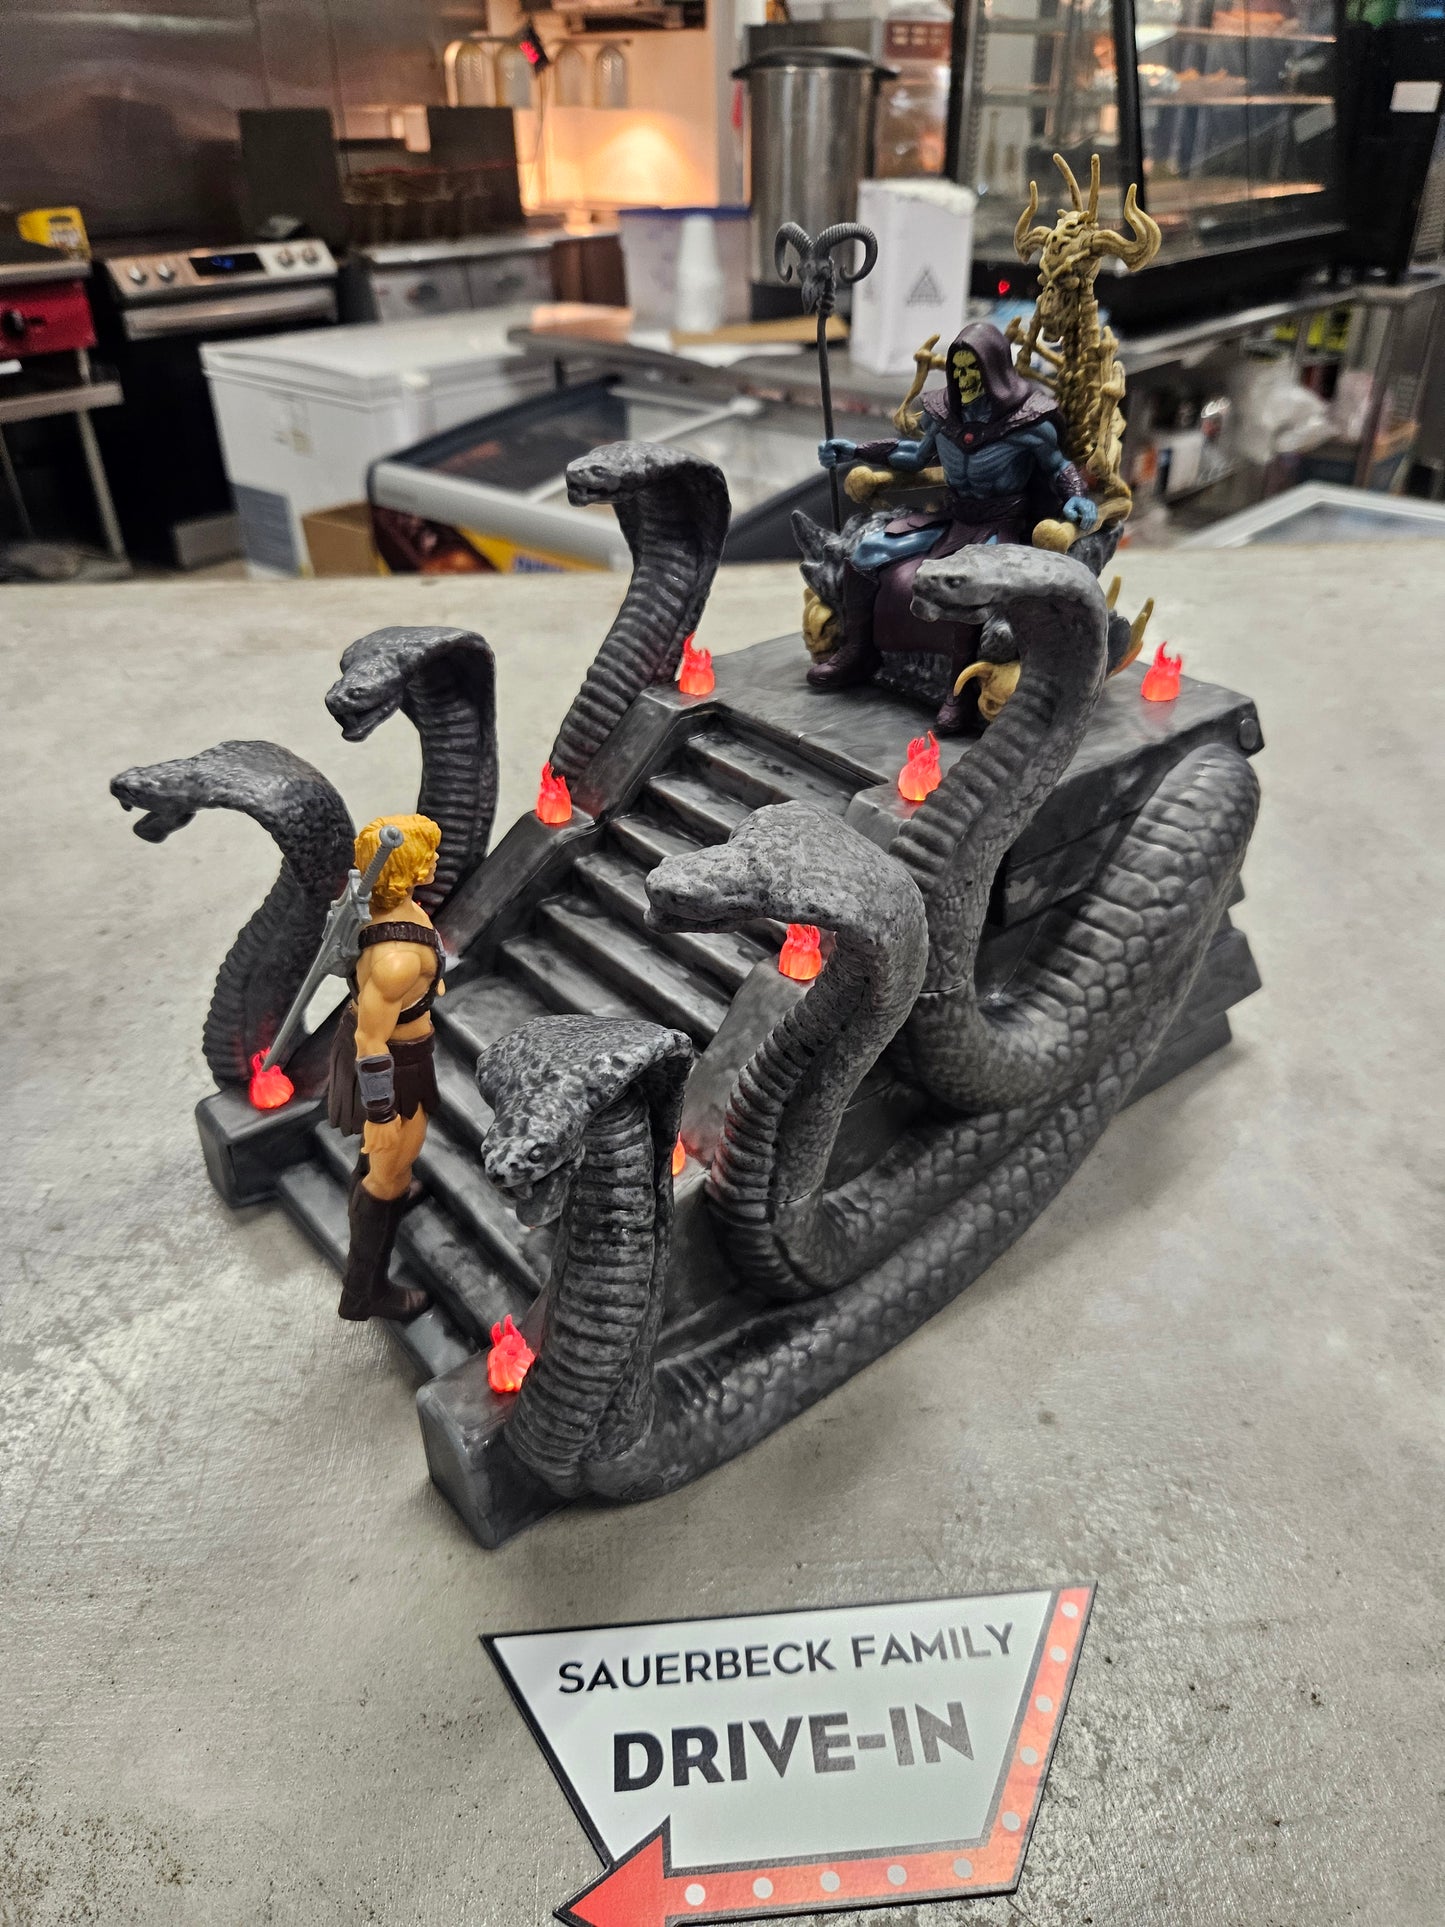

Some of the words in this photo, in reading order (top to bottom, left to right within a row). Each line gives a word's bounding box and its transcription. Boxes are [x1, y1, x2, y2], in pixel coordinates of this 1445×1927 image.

[558, 1638, 836, 1693] SAUERBECK
[851, 1623, 1013, 1668] FAMILY
[613, 1701, 975, 1792] DRIVE-IN
